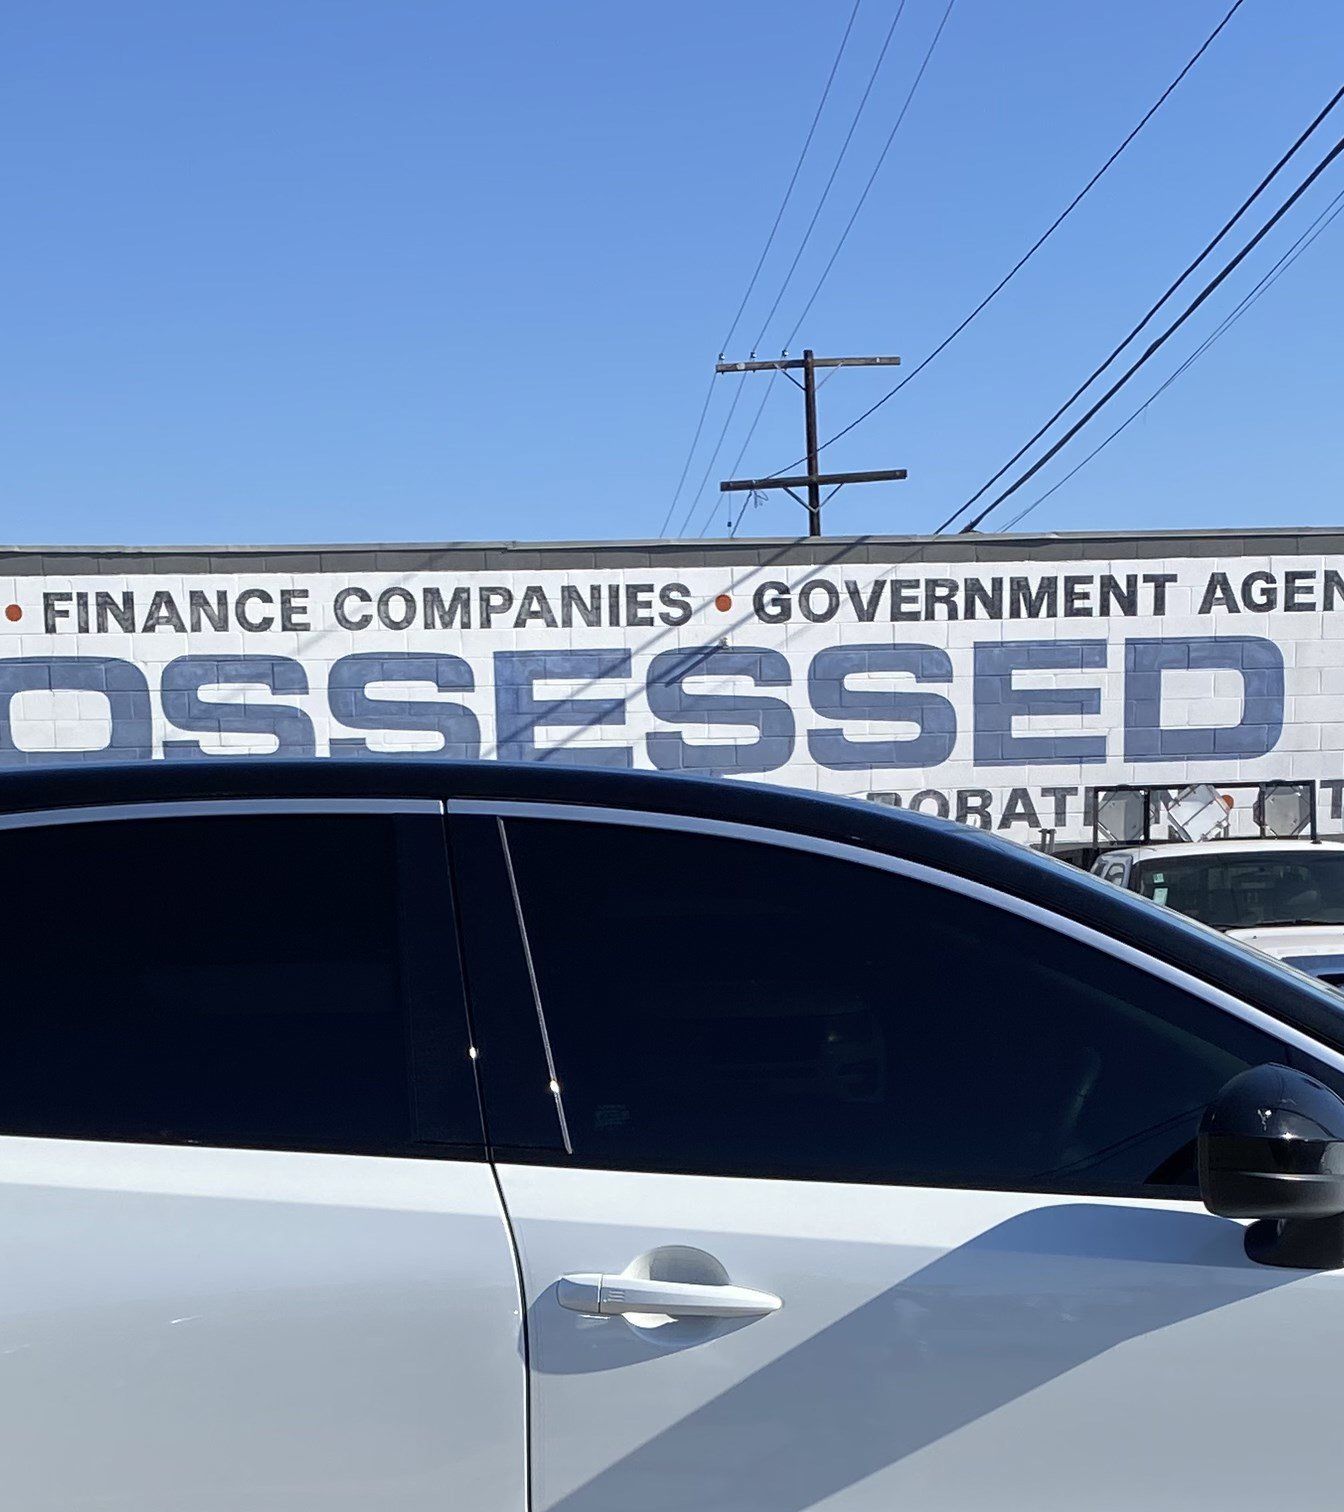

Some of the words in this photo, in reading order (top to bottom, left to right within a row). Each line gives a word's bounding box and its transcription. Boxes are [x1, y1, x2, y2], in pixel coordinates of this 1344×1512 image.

[42, 588, 311, 635] FINANCE
[333, 582, 693, 632] COMPANIES
[753, 573, 1178, 624] GOVERNMENT
